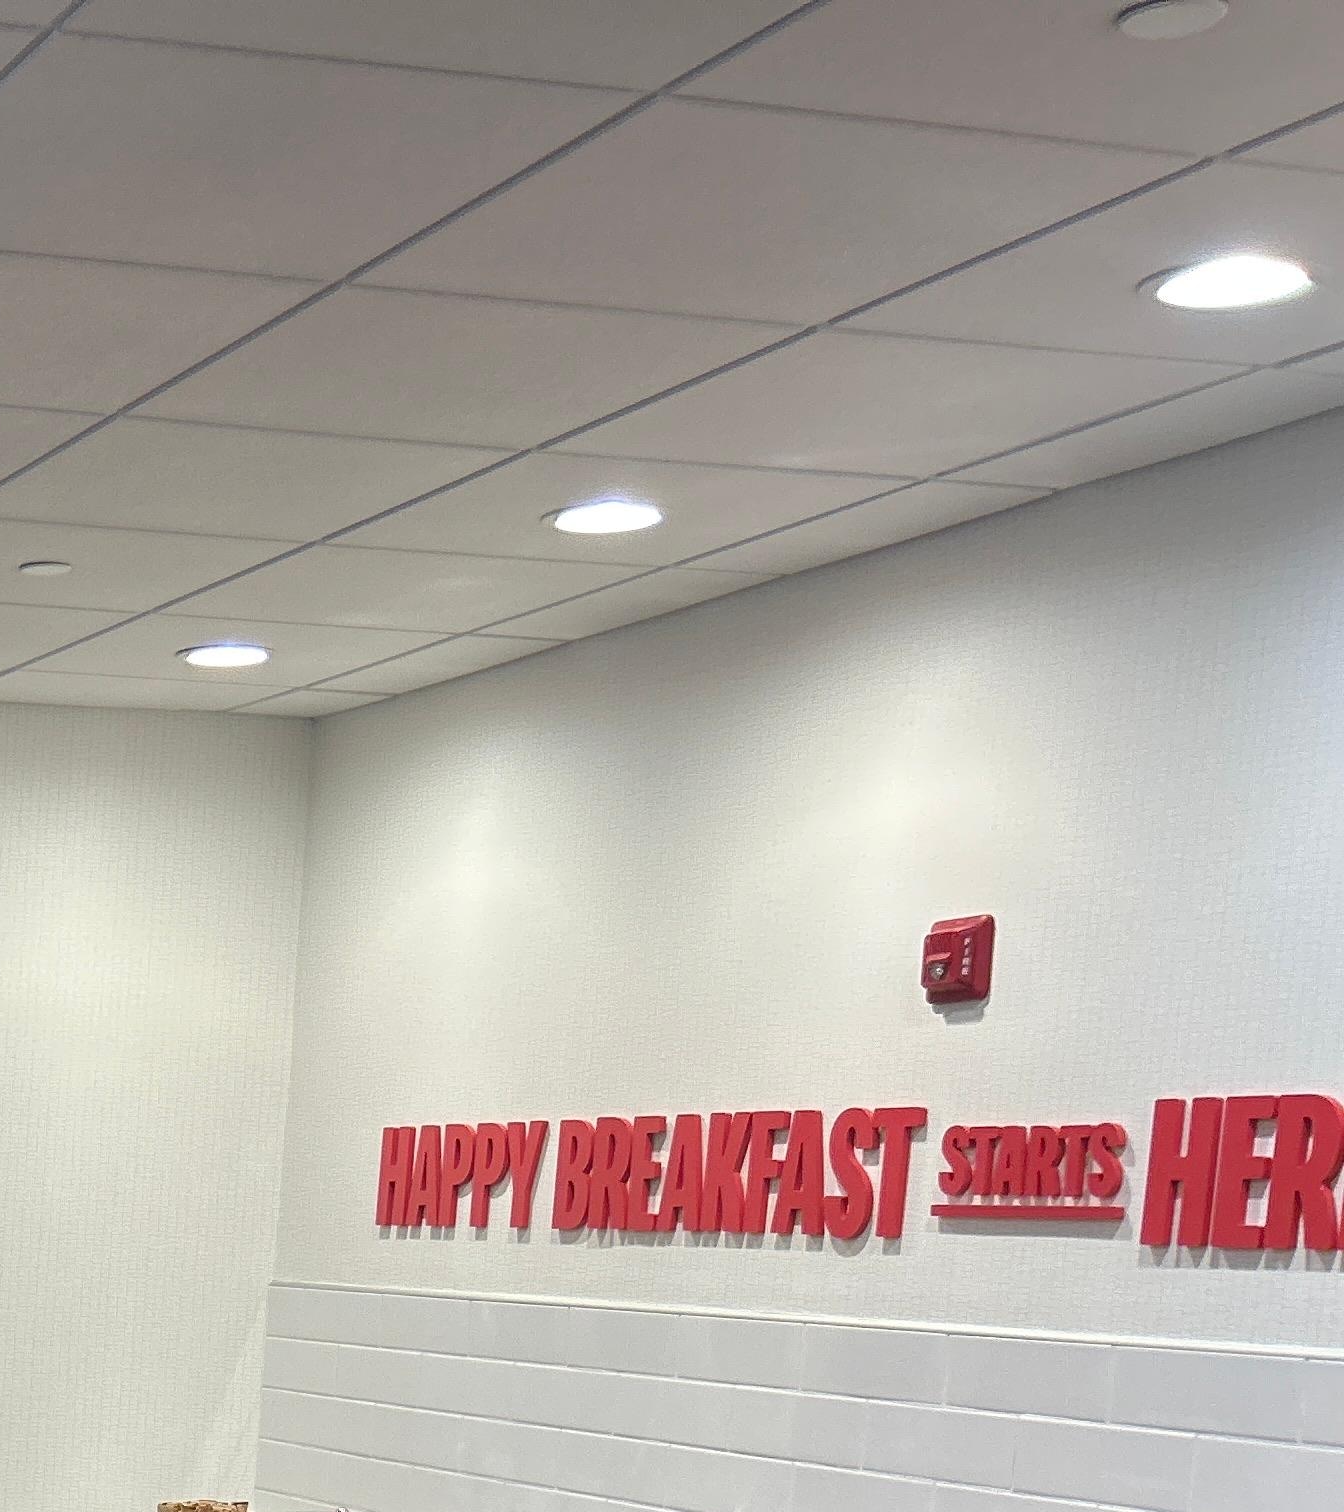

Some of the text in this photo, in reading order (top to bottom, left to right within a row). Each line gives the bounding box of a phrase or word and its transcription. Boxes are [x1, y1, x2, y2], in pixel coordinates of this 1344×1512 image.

[375, 1093, 1344, 1250] HAPPY BREAKFAST STARTS HER
